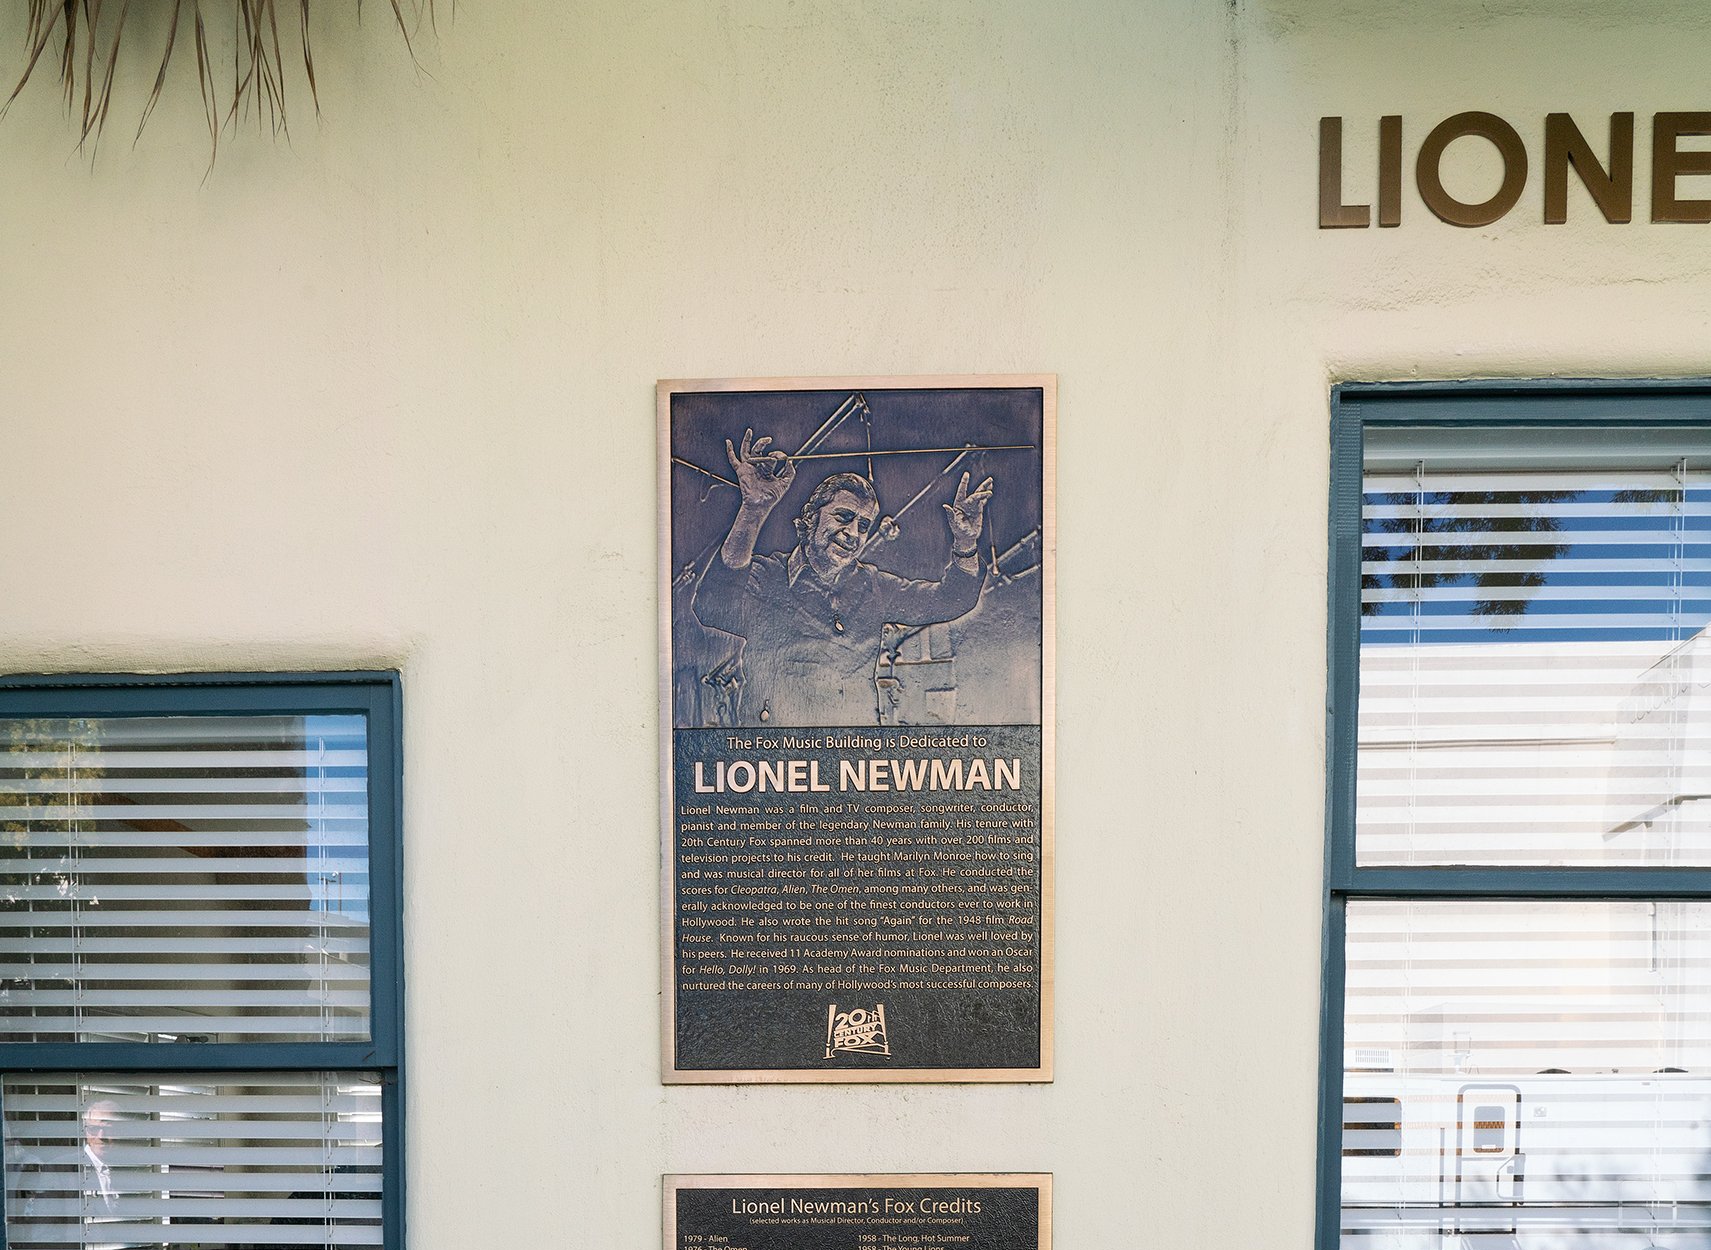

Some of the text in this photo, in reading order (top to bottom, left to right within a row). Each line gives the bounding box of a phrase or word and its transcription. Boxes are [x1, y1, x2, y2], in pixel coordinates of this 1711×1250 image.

[727, 735, 986, 751] The Fox Music Building is Dedicated to
[695, 759, 1020, 793] LIONEL NEWMAN
[681, 803, 1033, 816] Lionel Newman was a film and TV composer, songwriter, conductor,
[681, 818, 1033, 833] pianist and member of the legendary Newman family. His tenure with
[681, 834, 1033, 849] 20th Century Fox spanned more than 40 years with over 200 films and
[681, 851, 1033, 865] television projects to his credit. He taught Marilyn Monroe how to sing
[681, 899, 1032, 913] erally acknowledged to be one of the finest conductors ever to work in
[682, 931, 1032, 943] House. Known for his raucous sense of humor, Lionel was well loved by
[682, 947, 1032, 961] his peers. He received 11 Academy Award nominations and won an Oscar
[834, 1023, 877, 1038] CENTURY
[834, 1034, 876, 1047] FOX
[732, 1199, 784, 1214] Lionel
[885, 1198, 914, 1213] Fox
[919, 1198, 981, 1213] Credits
